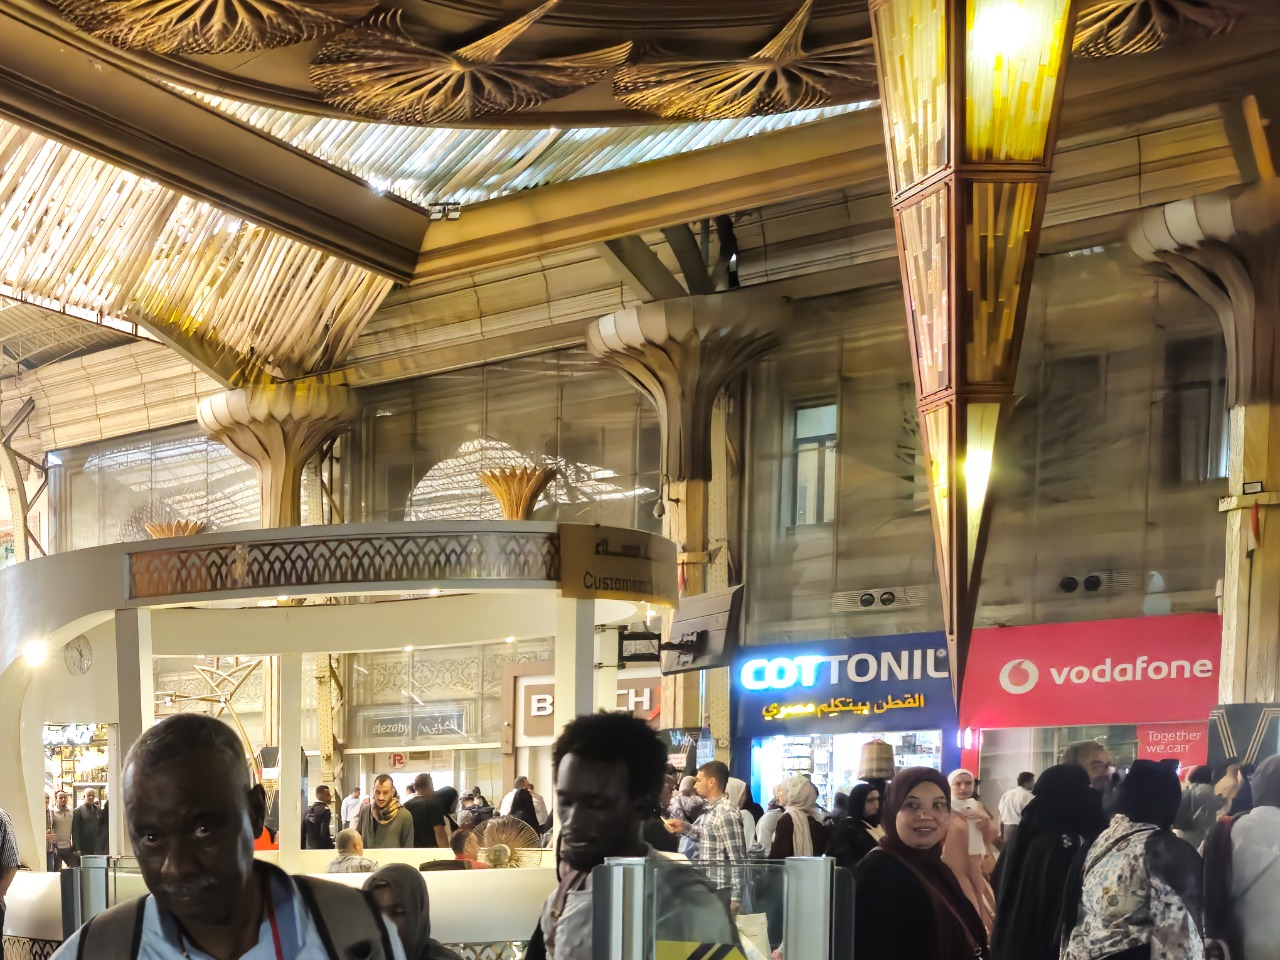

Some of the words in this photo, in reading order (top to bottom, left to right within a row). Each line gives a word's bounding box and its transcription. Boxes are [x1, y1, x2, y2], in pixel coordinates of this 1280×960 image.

[583, 571, 645, 593] Custom
[741, 649, 949, 690] COTTONIL
[1049, 656, 1213, 685] vodafone
[761, 702, 816, 720] مصري
[873, 694, 924, 714] القطن
[372, 722, 410, 736] elezaby
[1147, 730, 1202, 744] Together
[1146, 744, 1165, 753] we
[1167, 743, 1189, 753] can
